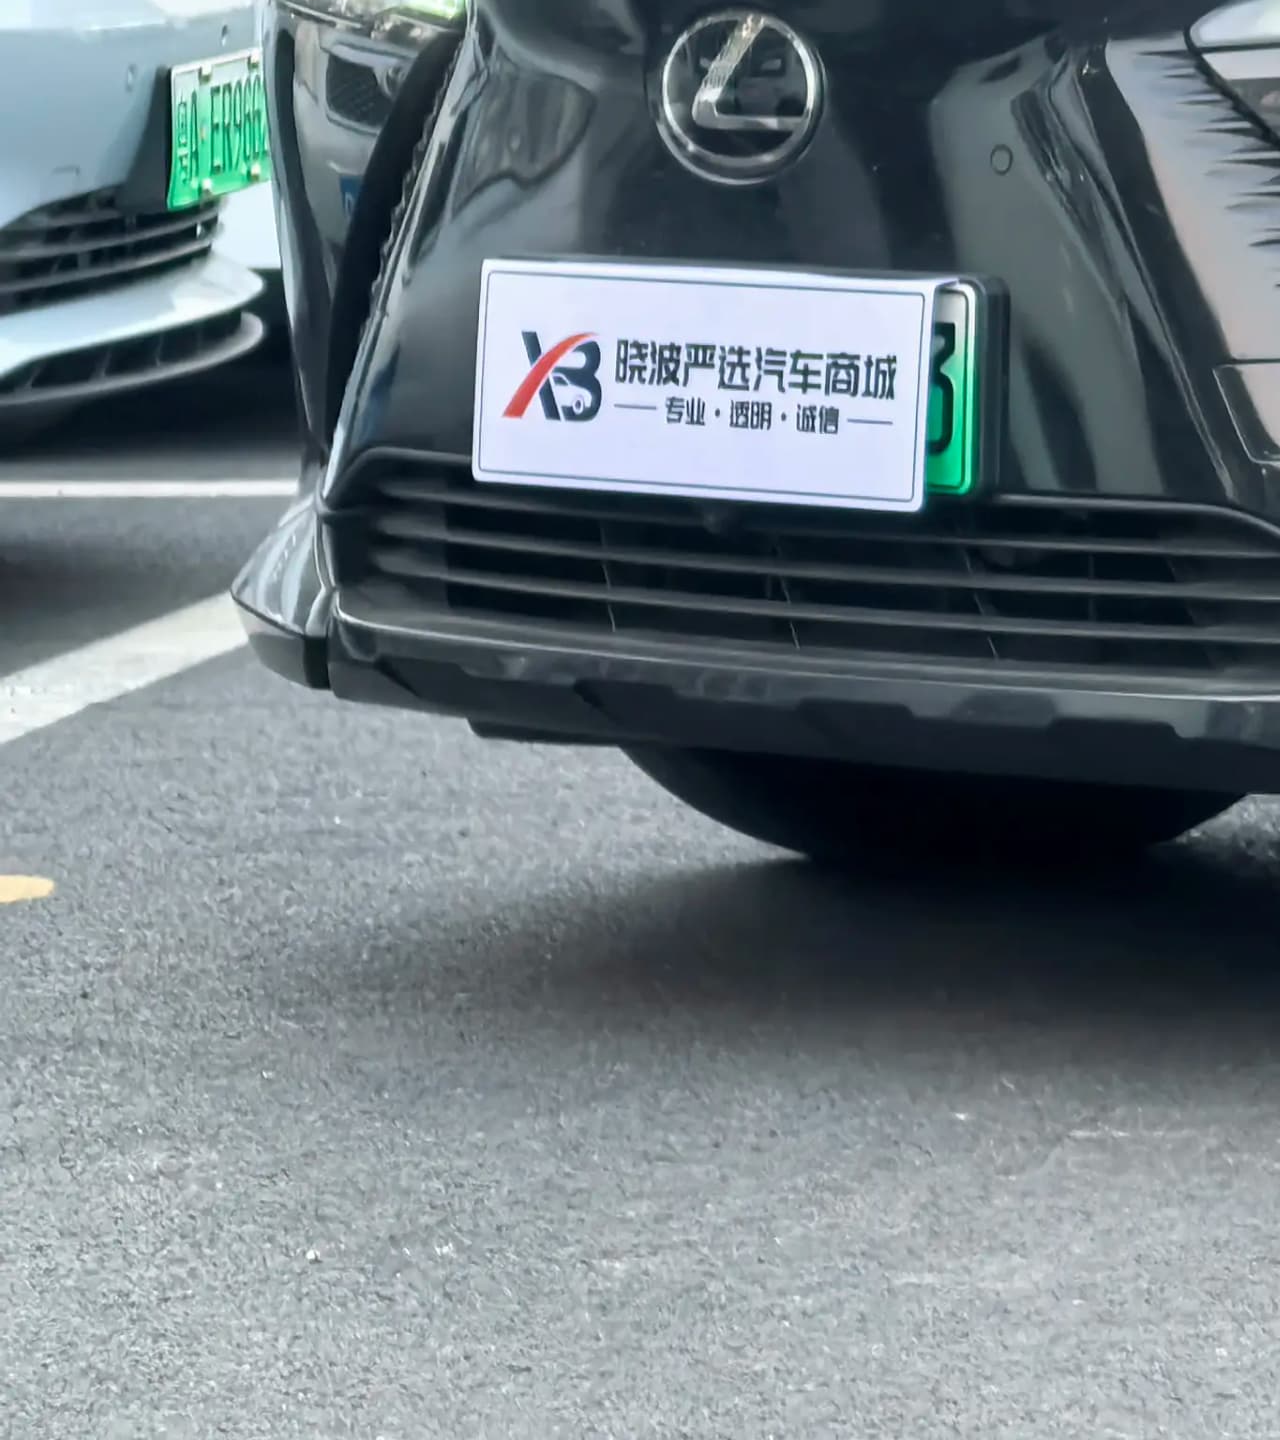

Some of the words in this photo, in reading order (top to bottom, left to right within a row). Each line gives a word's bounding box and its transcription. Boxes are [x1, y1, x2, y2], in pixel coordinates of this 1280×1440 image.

[614, 338, 897, 400] 晓波严选汽车商城
